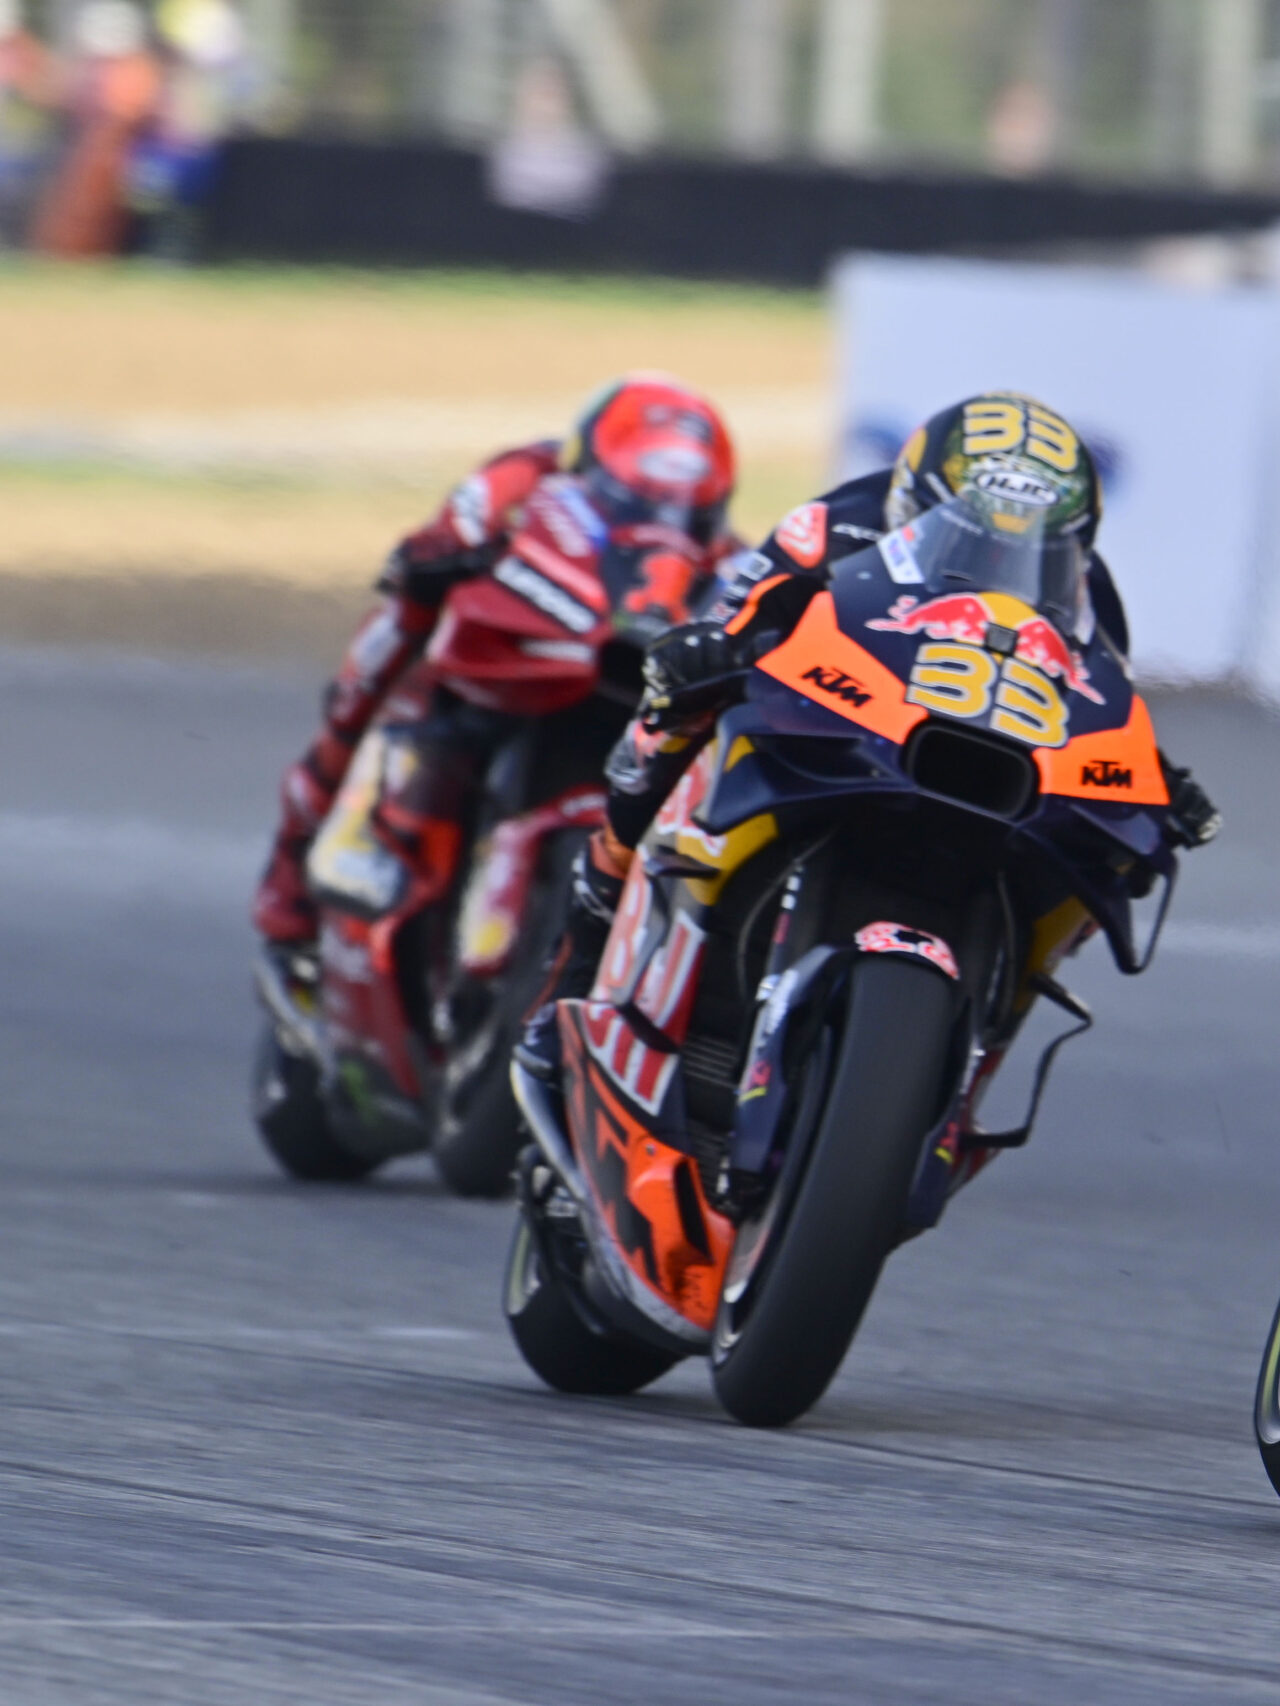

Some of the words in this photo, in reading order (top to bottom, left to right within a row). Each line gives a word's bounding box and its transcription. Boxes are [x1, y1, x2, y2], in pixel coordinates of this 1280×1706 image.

[963, 402, 1078, 472] 33
[801, 666, 874, 708] KTM
[906, 642, 1070, 748] 33
[1081, 760, 1133, 789] KTM
